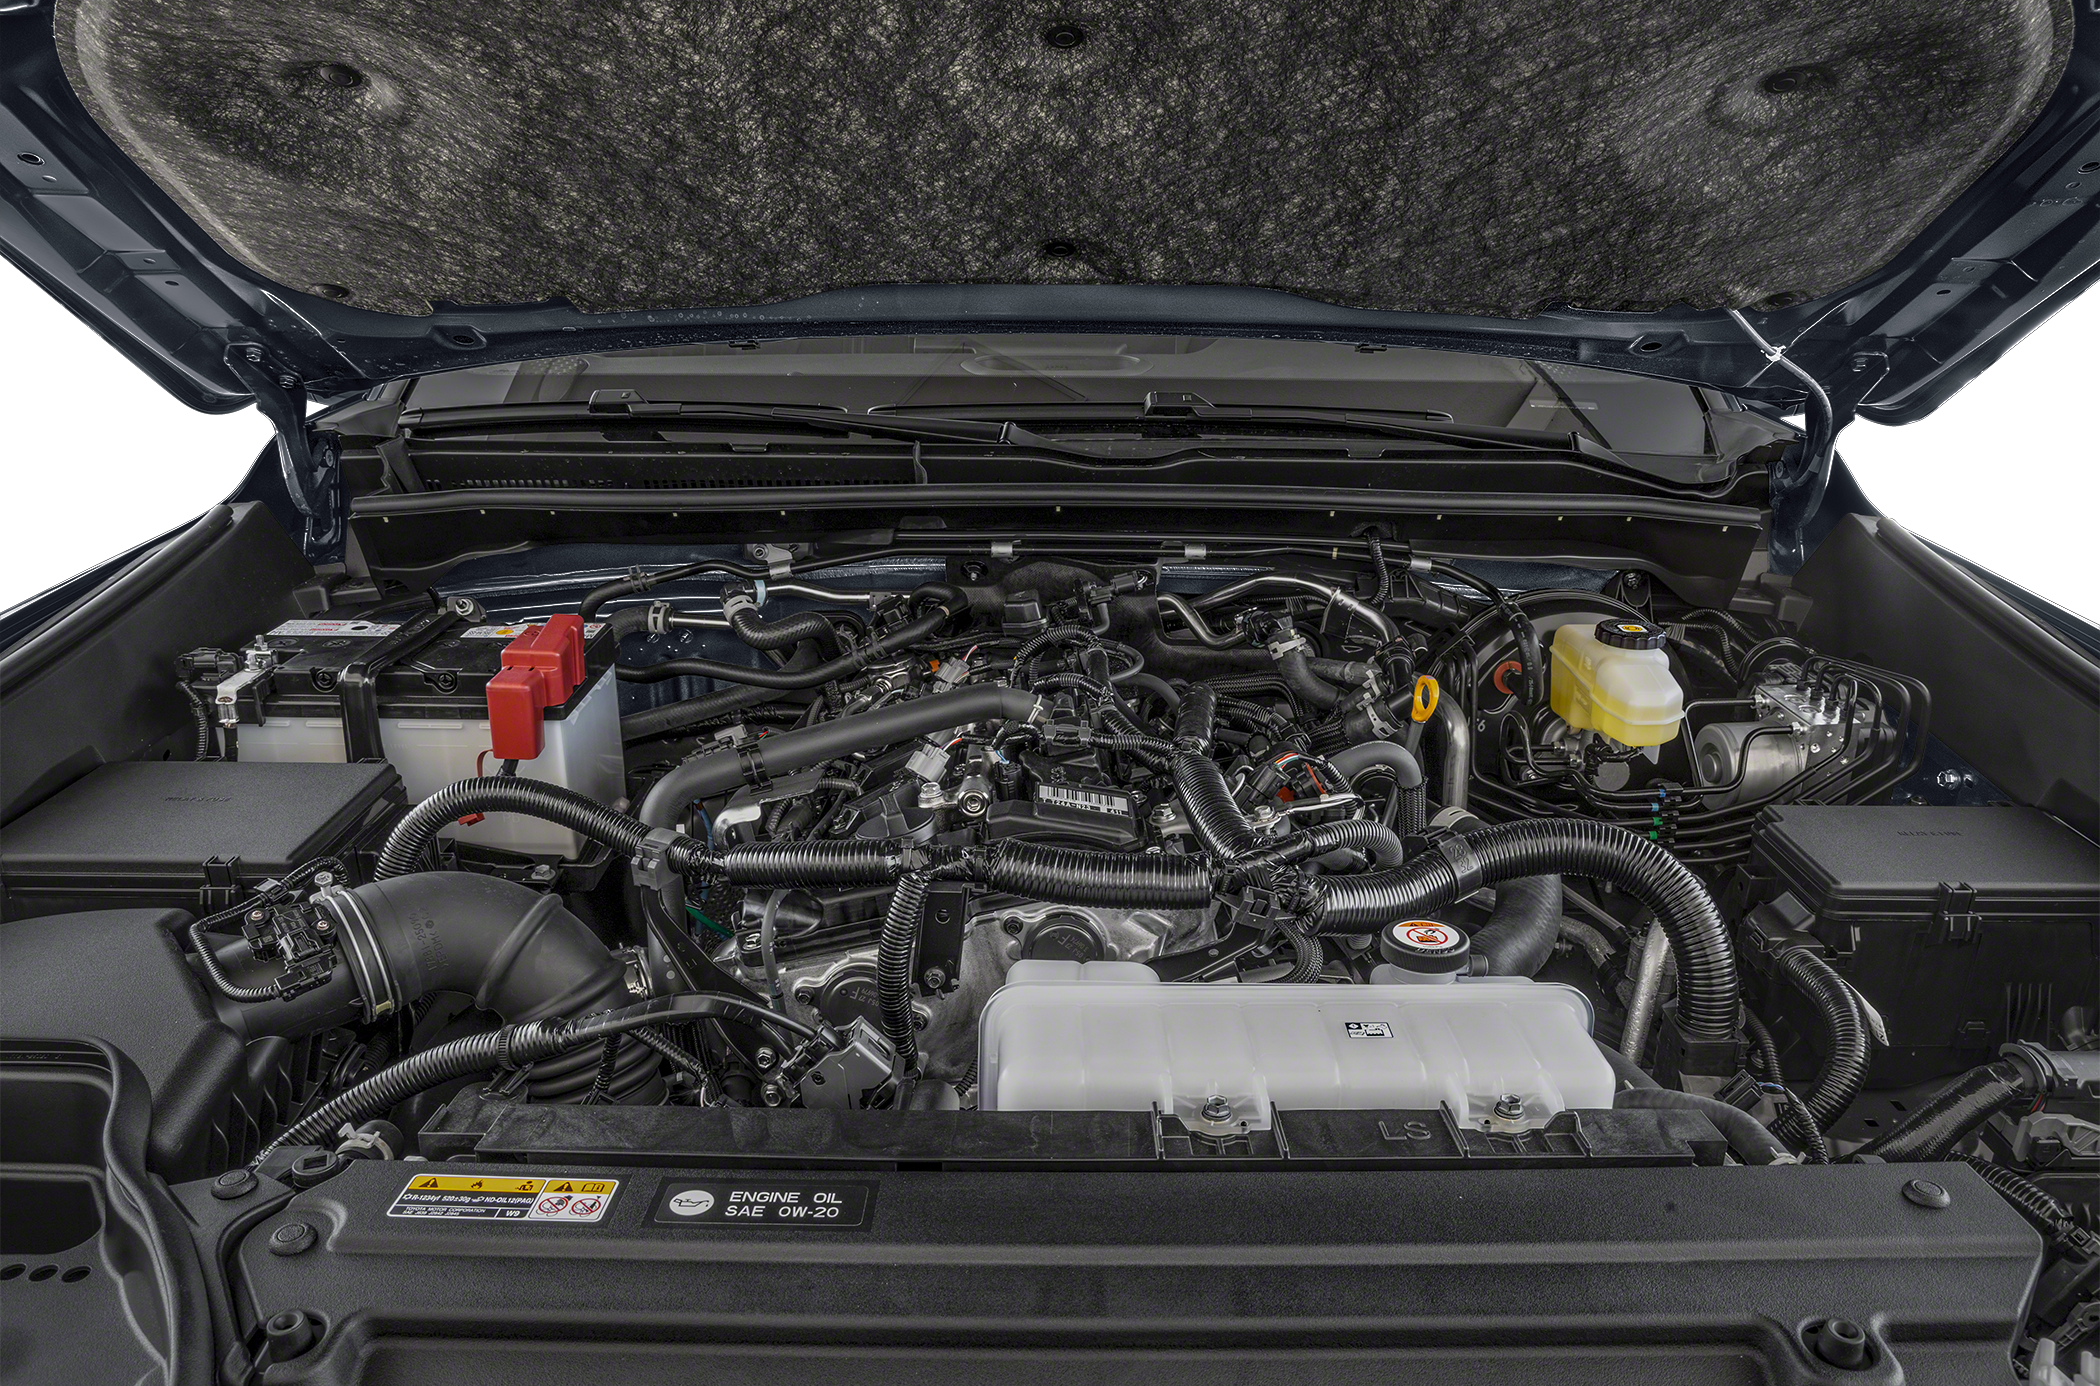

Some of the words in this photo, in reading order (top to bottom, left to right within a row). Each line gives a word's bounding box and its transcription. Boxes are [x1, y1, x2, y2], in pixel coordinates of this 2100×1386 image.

[1378, 1120, 1432, 1141] LS
[411, 1193, 440, 1202] R-1234yf
[729, 1191, 801, 1203] ENGINE
[813, 1192, 842, 1204] OIL
[725, 1205, 766, 1217] SAE
